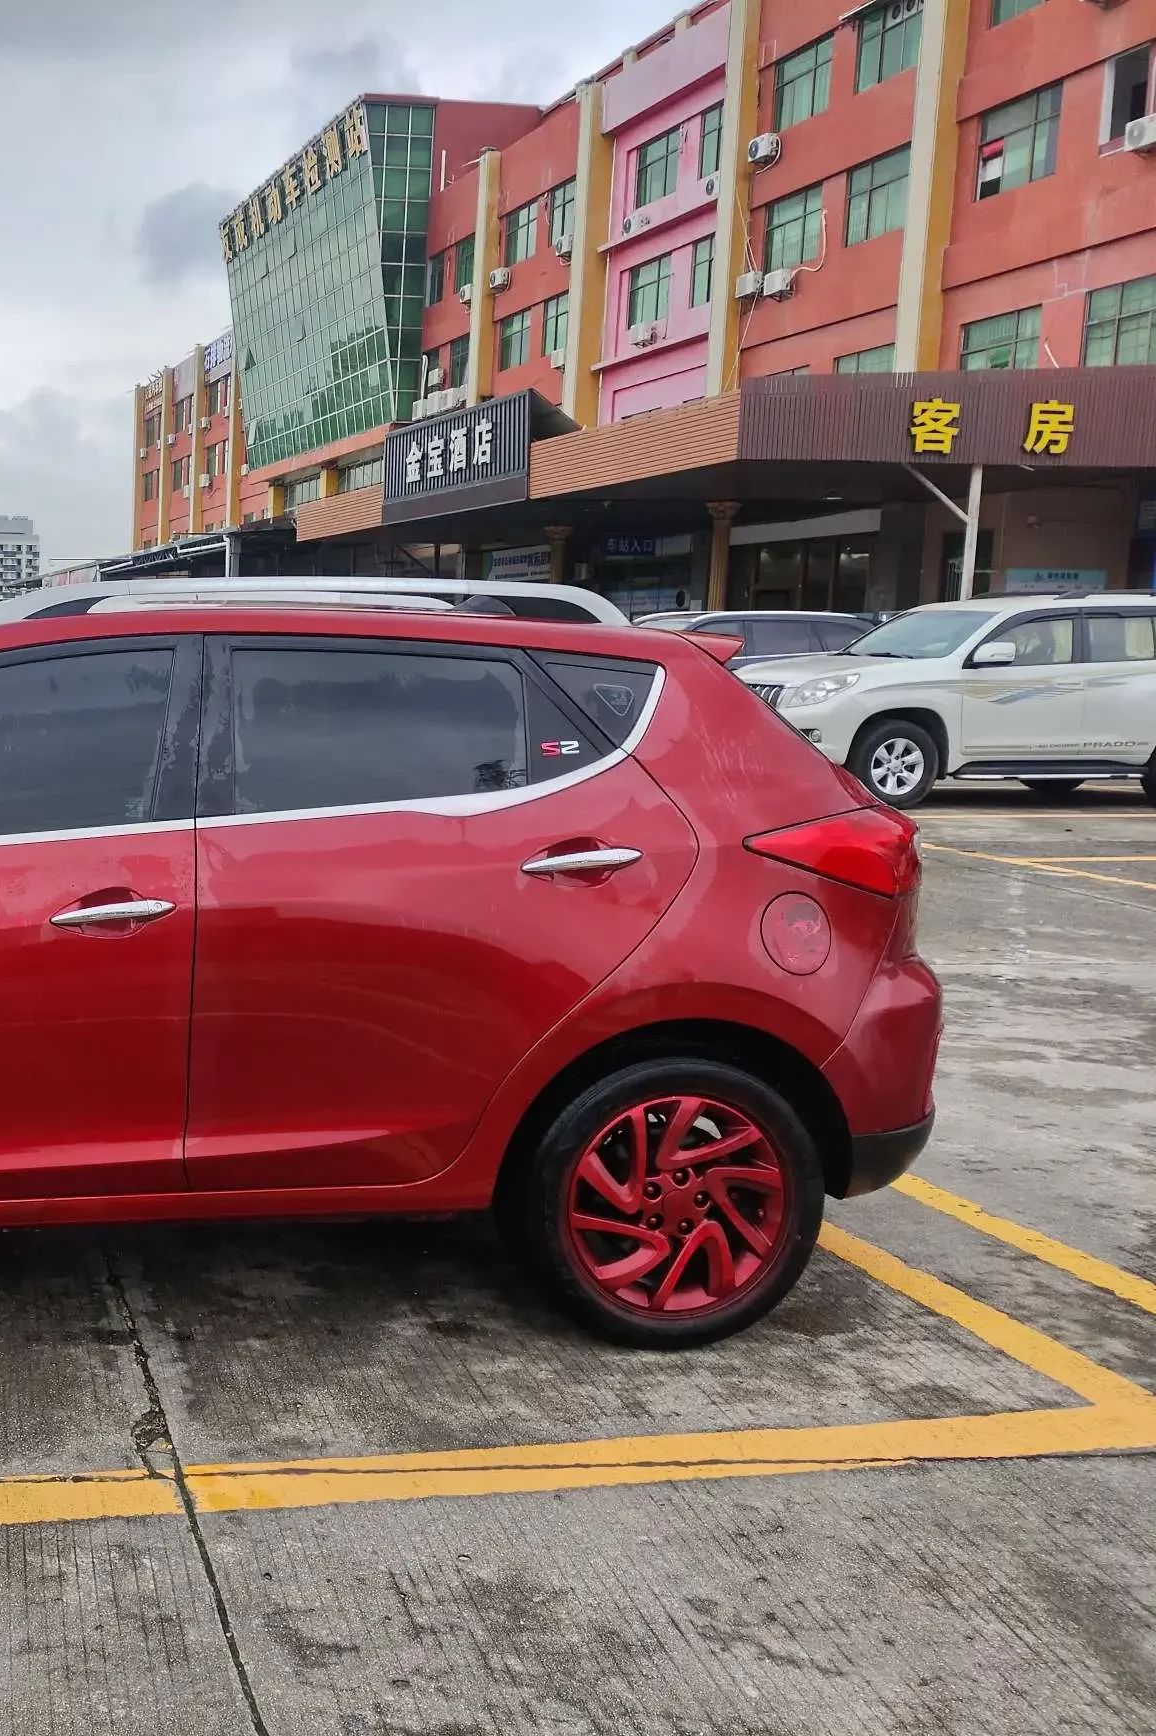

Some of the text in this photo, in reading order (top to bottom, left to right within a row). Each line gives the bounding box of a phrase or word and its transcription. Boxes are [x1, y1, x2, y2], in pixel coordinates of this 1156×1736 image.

[406, 417, 493, 483] 金宝酒店
[910, 398, 1075, 454] 客房
[540, 740, 580, 757] S2
